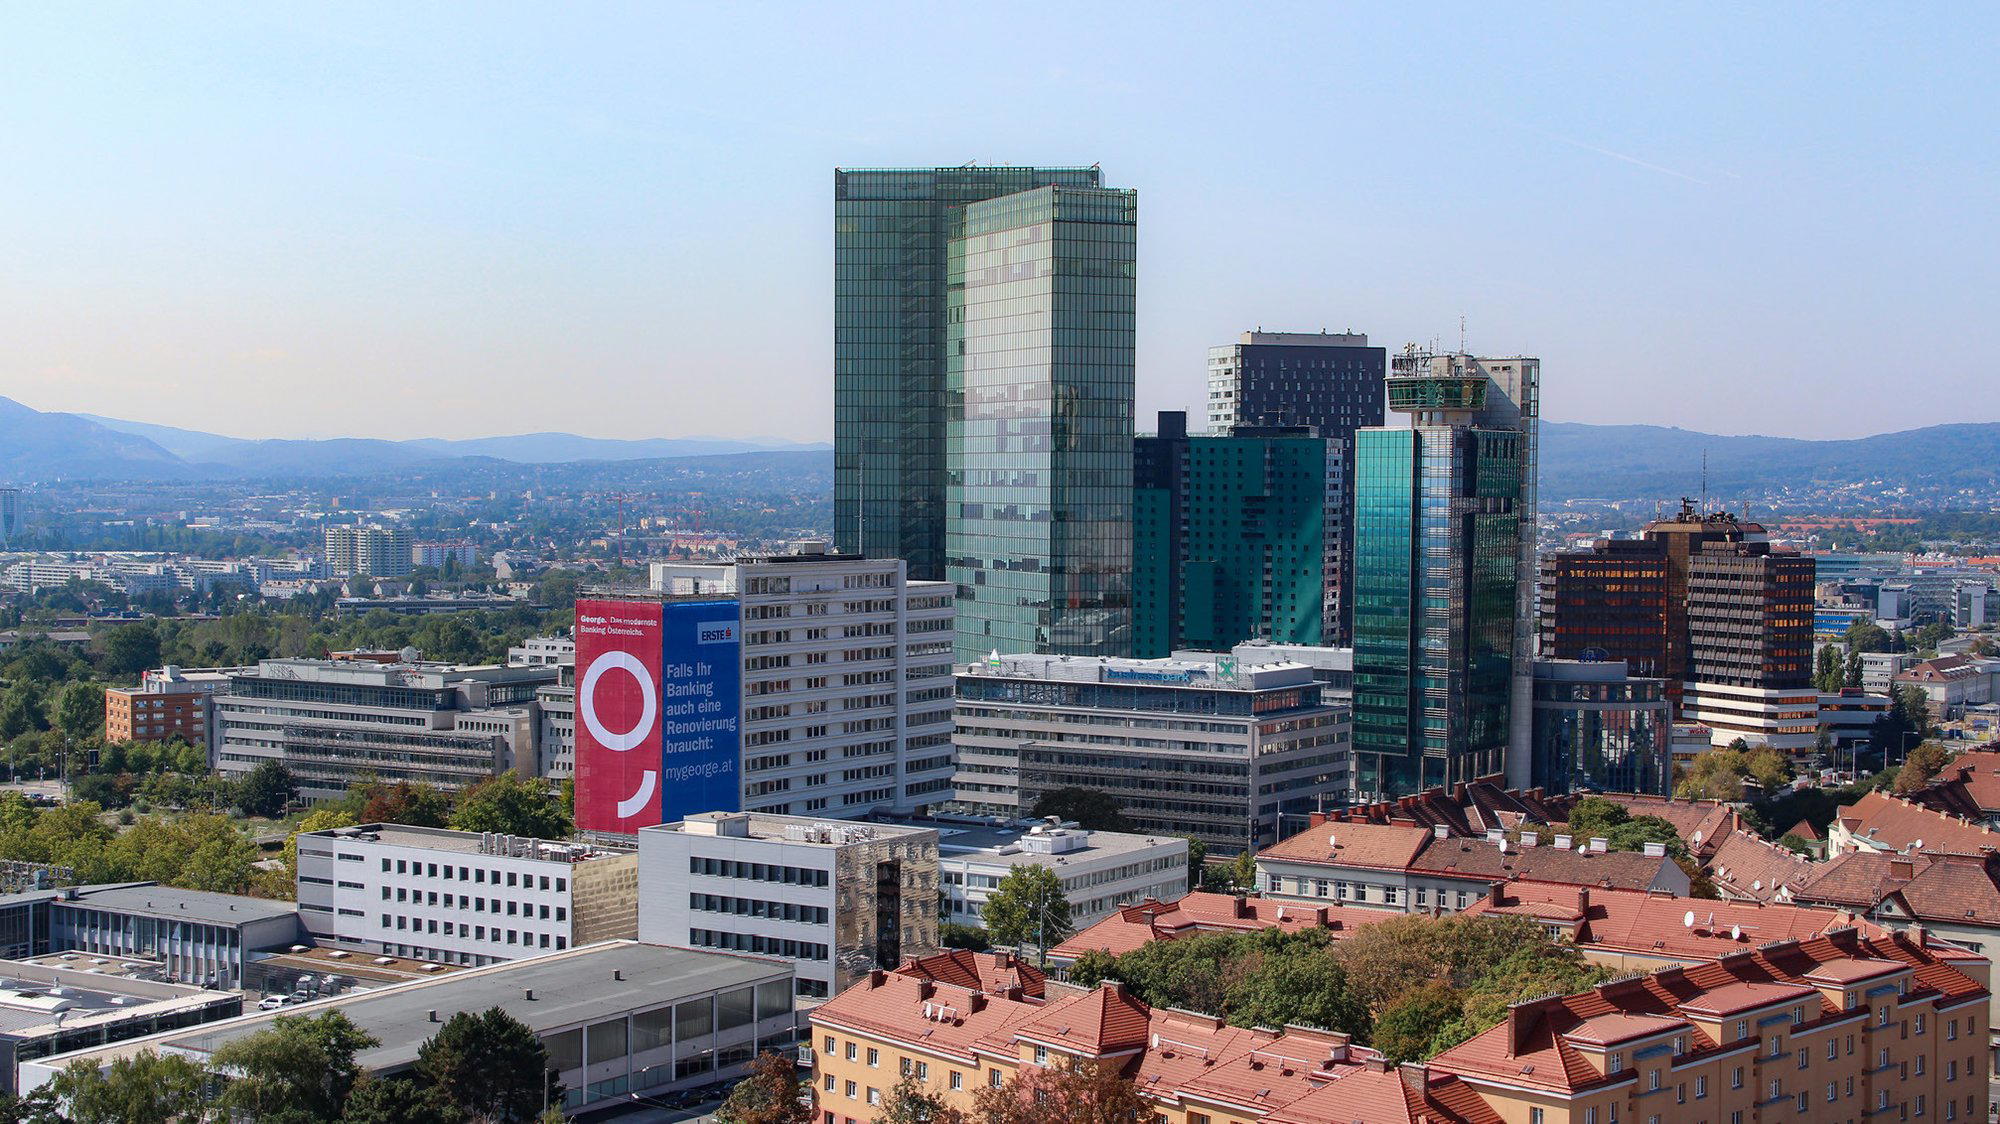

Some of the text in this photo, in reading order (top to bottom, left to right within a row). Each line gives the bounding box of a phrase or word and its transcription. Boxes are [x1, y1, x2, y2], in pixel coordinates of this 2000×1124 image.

[581, 615, 657, 626] George. Das modernste
[581, 625, 644, 636] Banking Österreichs.
[702, 630, 725, 641] ERSTE
[667, 662, 712, 679] Falls Ihr
[667, 681, 714, 698] Banking
[667, 699, 722, 716] auch eine
[667, 716, 736, 735] Renovierung
[667, 736, 713, 754] braucht:
[666, 758, 733, 782] mygeorge.at
